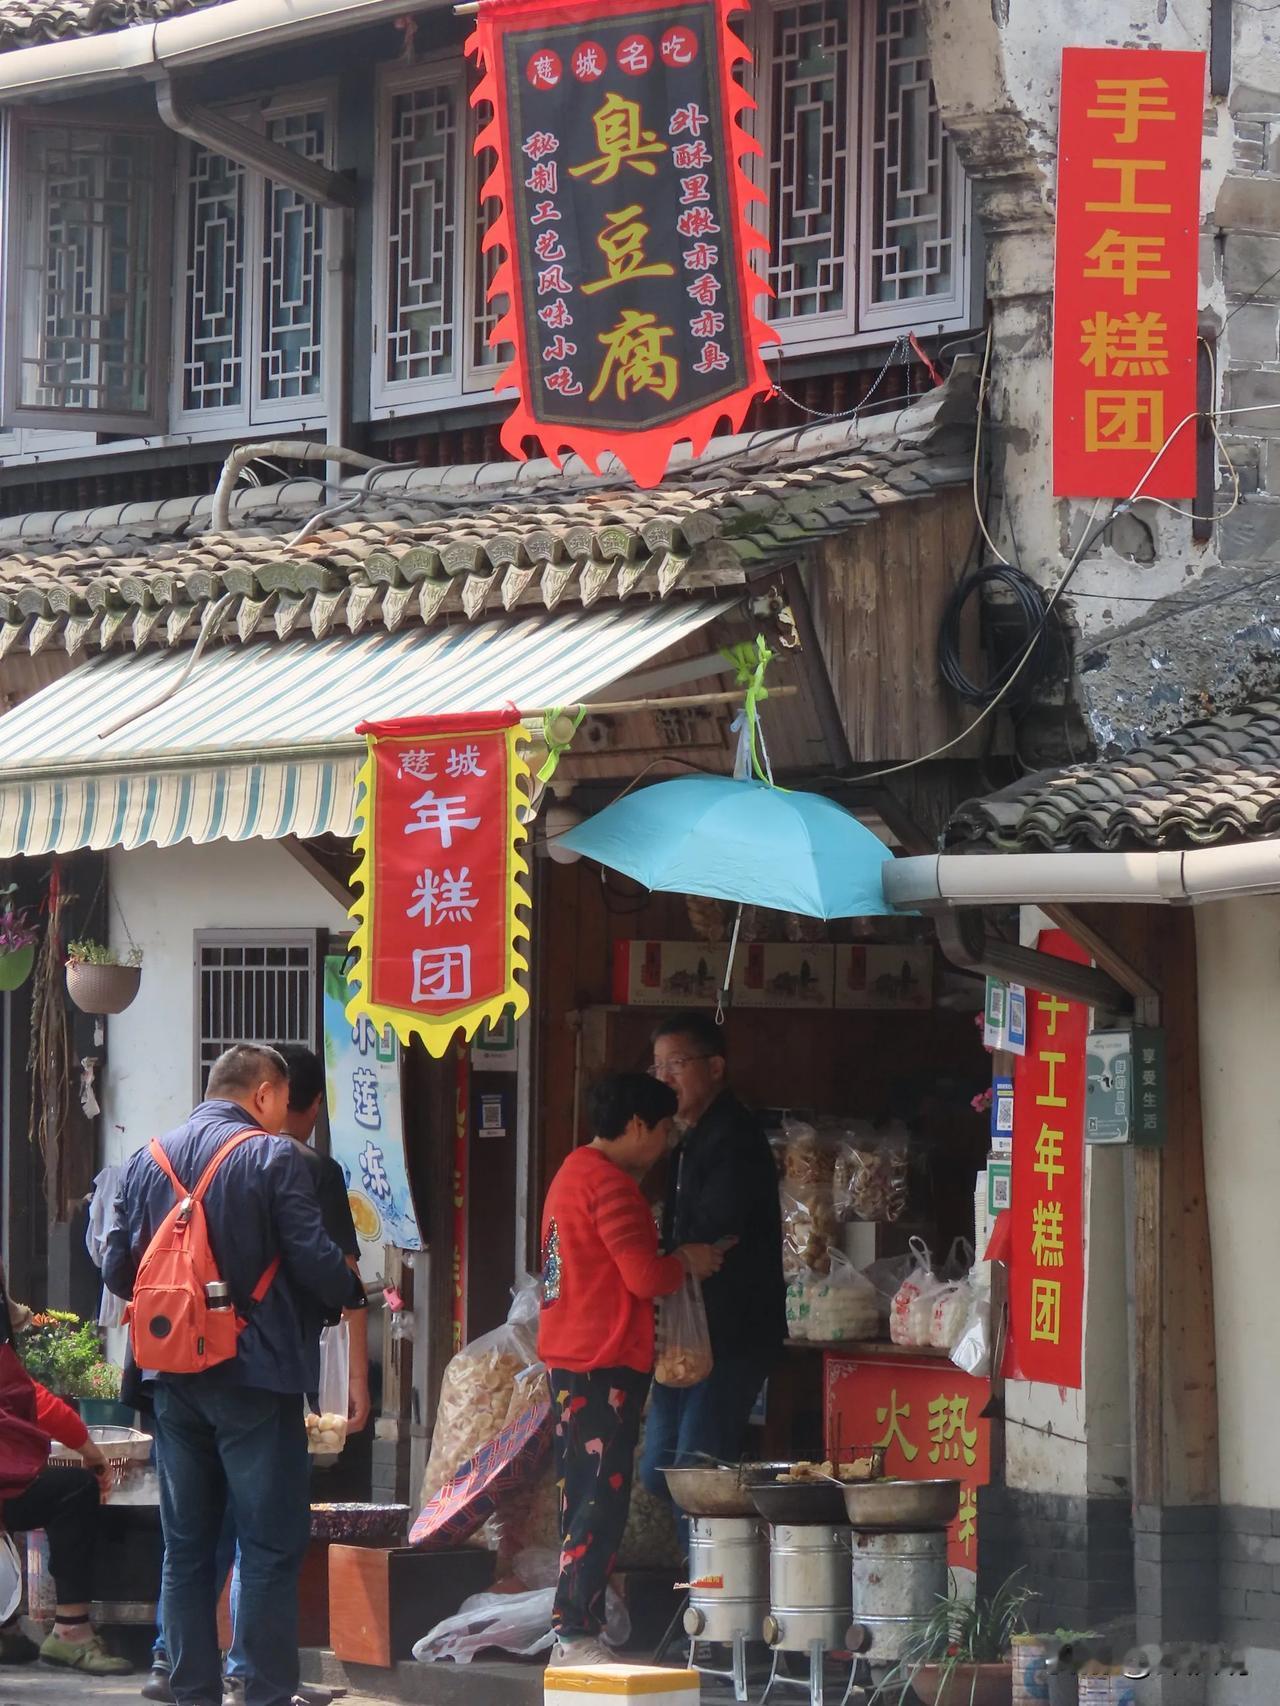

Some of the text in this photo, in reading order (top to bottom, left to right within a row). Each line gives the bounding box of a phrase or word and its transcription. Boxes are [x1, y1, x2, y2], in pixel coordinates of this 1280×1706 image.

[531, 34, 693, 86] 慈城名吃
[522, 131, 584, 397] 秘制工艺风味小吃
[568, 93, 679, 402] 臭豆腐
[668, 103, 730, 375] 外酥里嫩亦香亦臭
[1079, 76, 1176, 454] 手工年糕团
[396, 744, 488, 782] 慈城
[403, 790, 482, 1004] 年糕团
[351, 1011, 392, 1200] 小莲冻
[1030, 989, 1070, 1345] 手工年糕团
[1141, 1048, 1157, 1129] 享受生活
[873, 1388, 977, 1466] 火热
